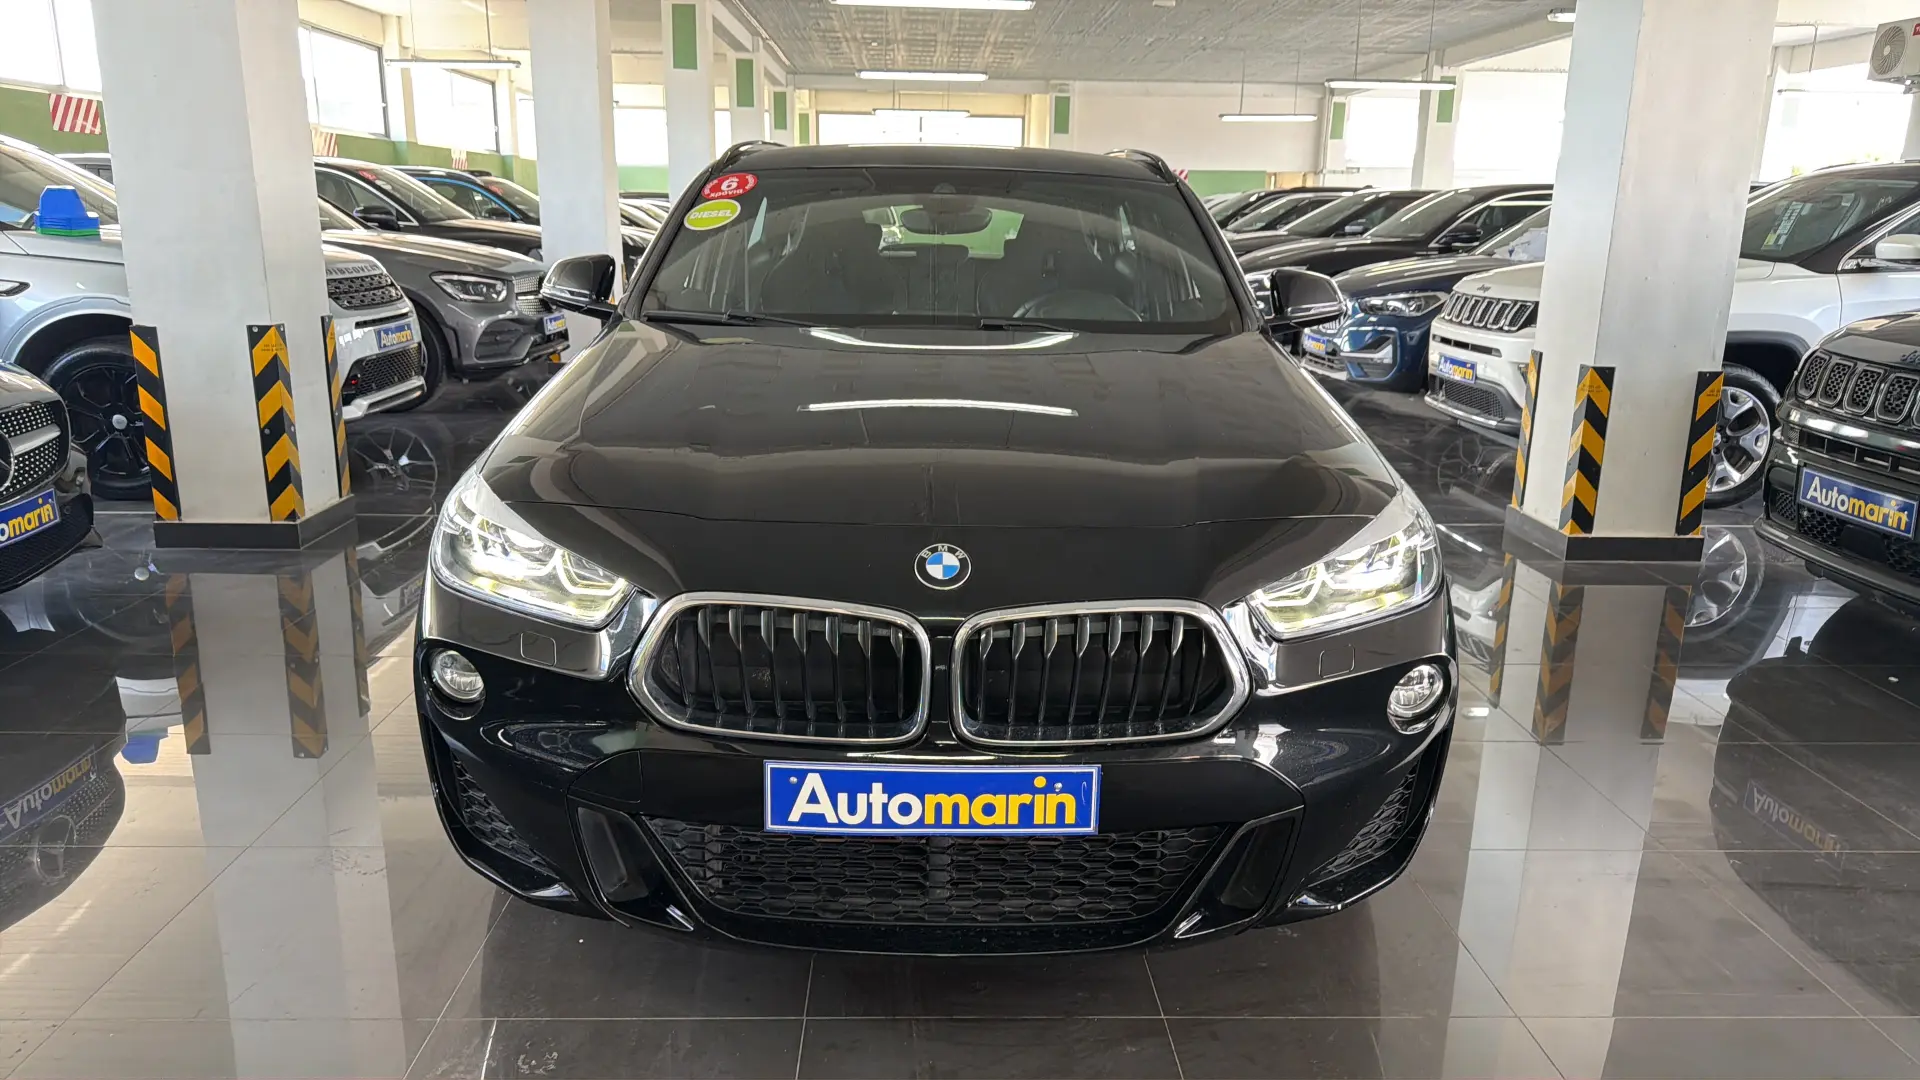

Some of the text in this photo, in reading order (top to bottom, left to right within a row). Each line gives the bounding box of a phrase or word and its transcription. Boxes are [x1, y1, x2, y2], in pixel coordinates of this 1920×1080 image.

[721, 178, 739, 191] 6
[690, 209, 732, 219] DIESEL
[1806, 476, 1908, 530] Automarin
[788, 772, 1076, 825] Automarin
